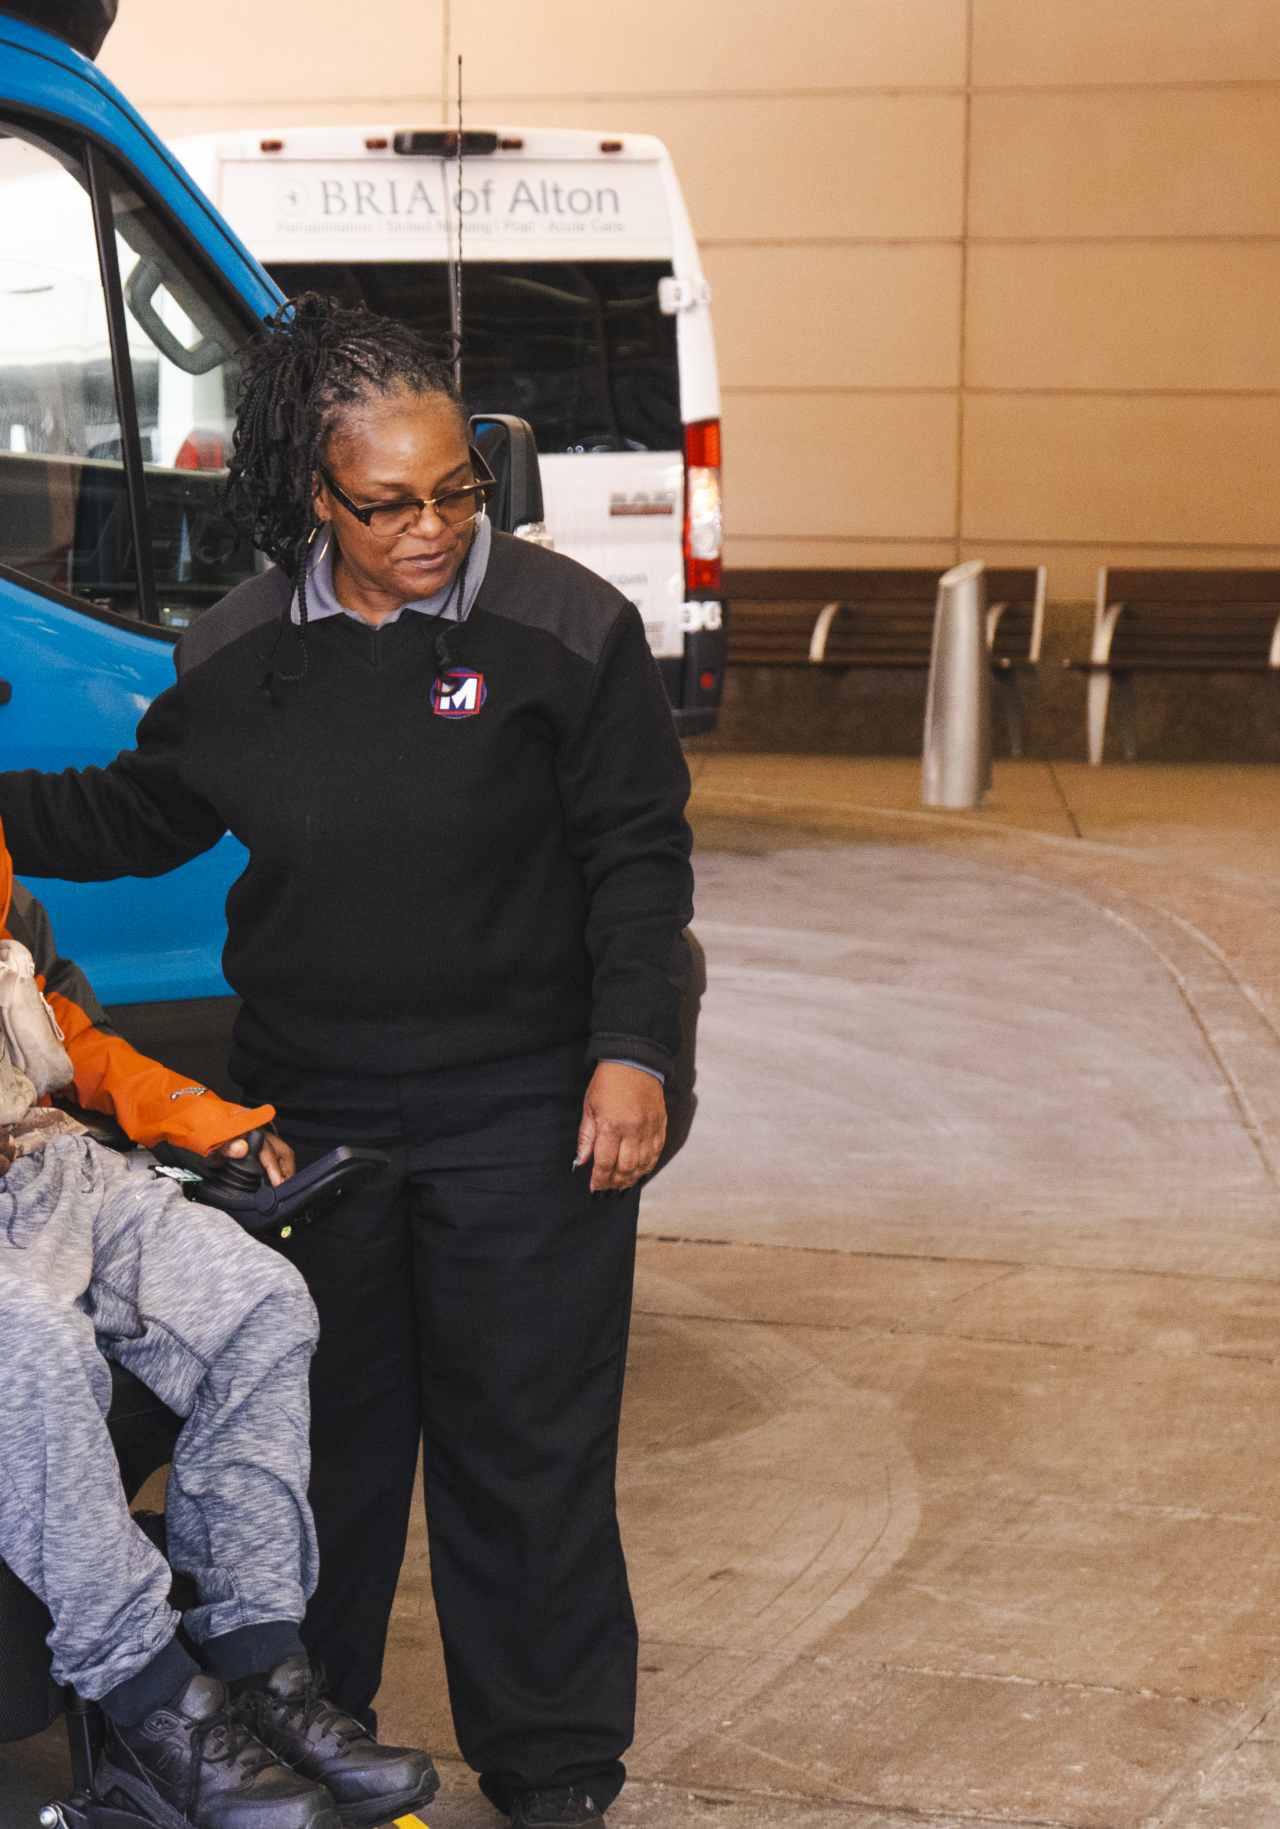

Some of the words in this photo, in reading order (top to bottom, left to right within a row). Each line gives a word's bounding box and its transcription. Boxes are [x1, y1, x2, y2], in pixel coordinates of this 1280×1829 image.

[319, 179, 437, 215] BRIA
[453, 179, 493, 215] of
[508, 179, 620, 215] Alton
[387, 220, 433, 233] Skilled
[437, 220, 492, 235] Nusing
